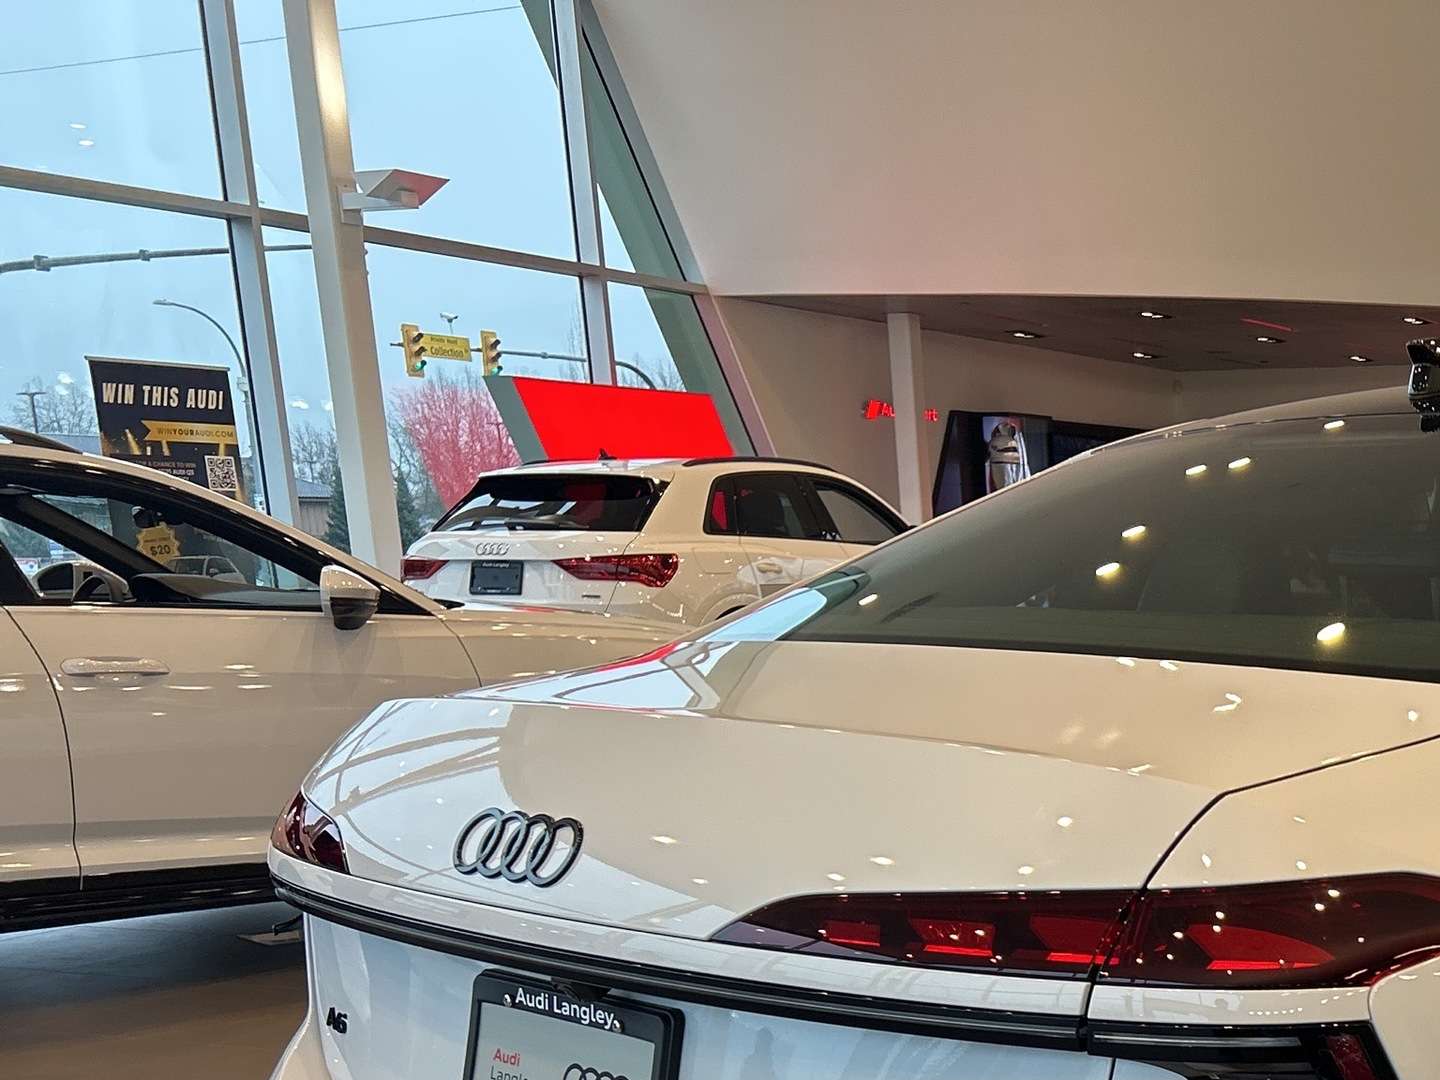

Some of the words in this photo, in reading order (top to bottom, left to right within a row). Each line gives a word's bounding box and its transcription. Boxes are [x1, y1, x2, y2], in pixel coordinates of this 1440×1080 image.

[102, 382, 135, 405] WIN
[142, 385, 180, 407] THIS
[186, 388, 224, 410] AUDI
[157, 427, 234, 438] WINYOURAUDI.COM
[326, 1007, 348, 1034] A6
[515, 987, 549, 1011] Audi
[553, 995, 615, 1029] Langley
[493, 1048, 521, 1067] Audi
